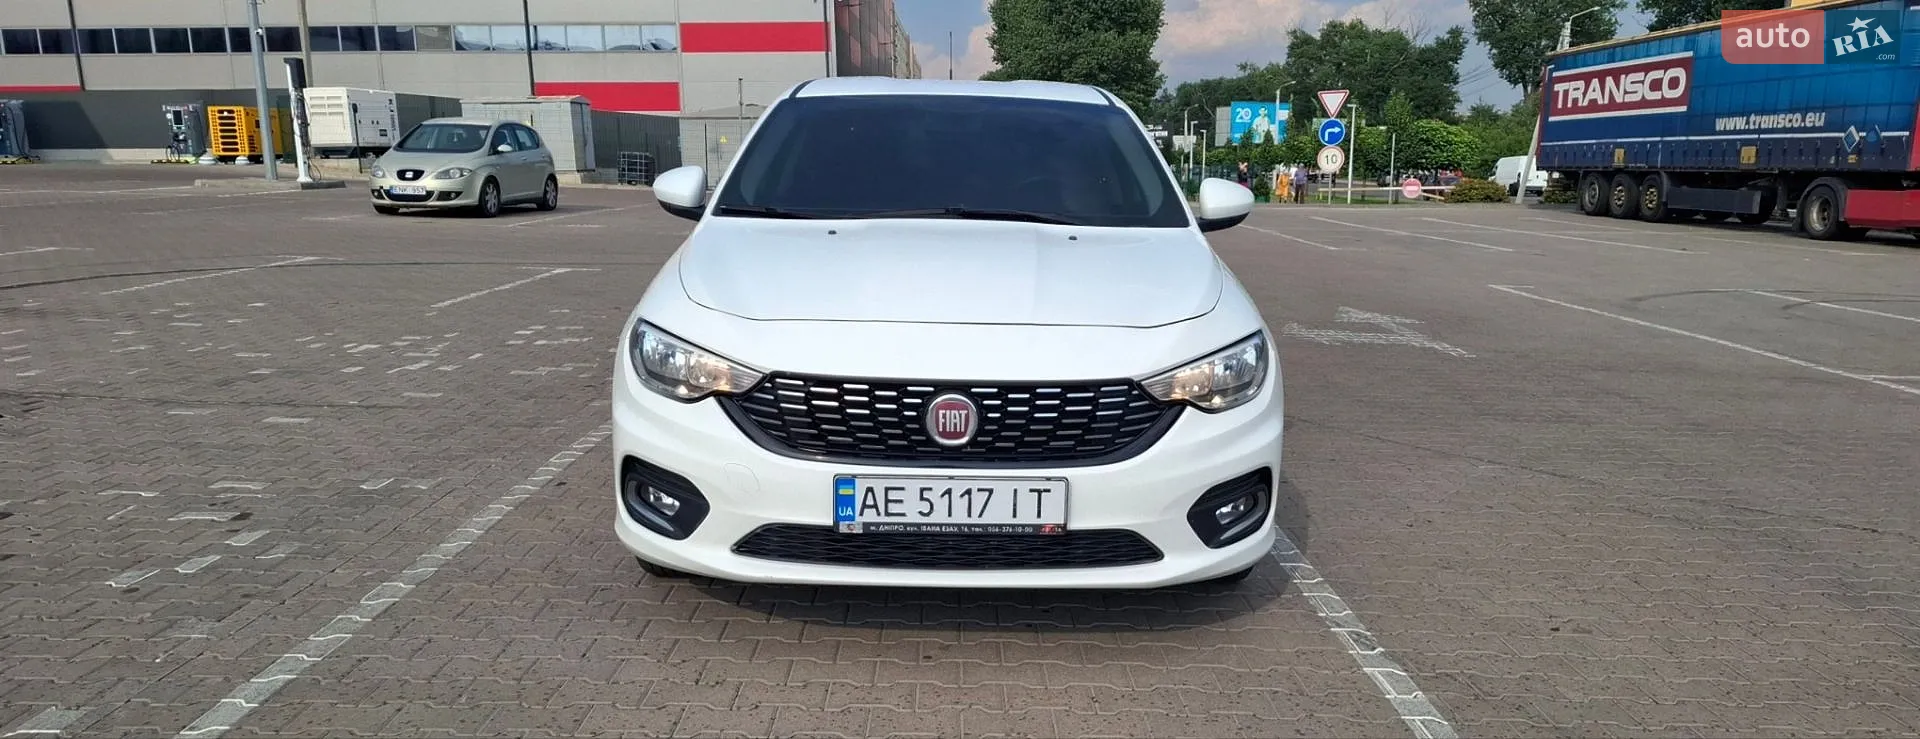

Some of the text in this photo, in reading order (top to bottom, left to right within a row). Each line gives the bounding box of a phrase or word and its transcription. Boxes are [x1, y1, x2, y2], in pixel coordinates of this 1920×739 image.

[1553, 66, 1686, 109] TRANSCO
[1715, 112, 1825, 131] www.transco.eu
[1324, 154, 1338, 165] 10
[938, 410, 968, 432] FIAT
[838, 506, 853, 516] UA
[858, 486, 1051, 519] AE 5117 IT
